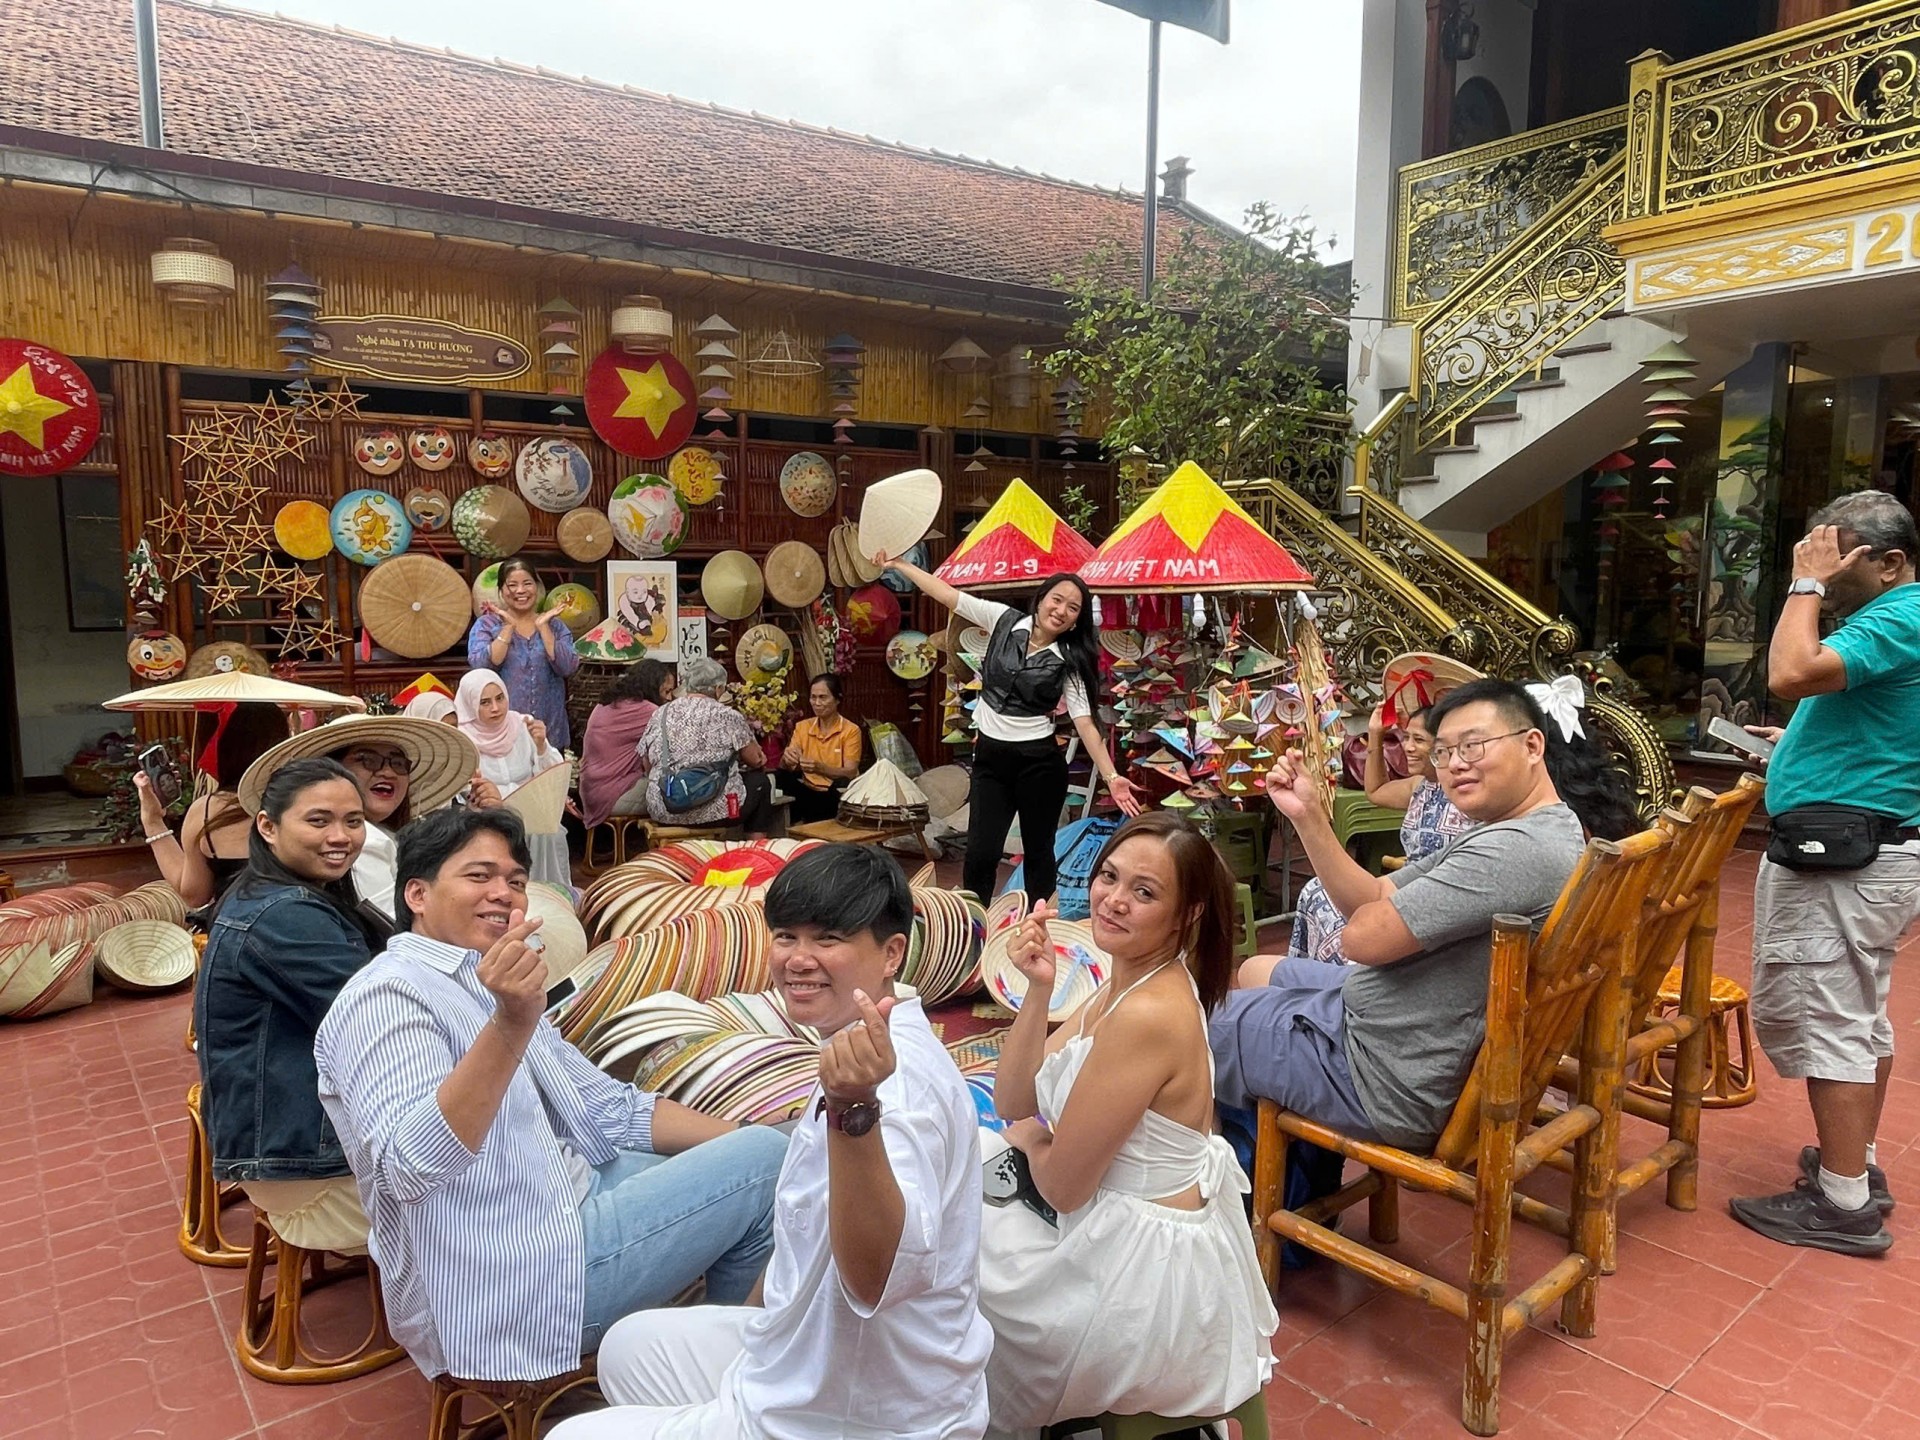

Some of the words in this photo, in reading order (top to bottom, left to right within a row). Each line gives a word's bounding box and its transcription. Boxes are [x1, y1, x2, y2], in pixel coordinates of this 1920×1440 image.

[1864, 211, 1920, 267] 2
[356, 334, 379, 347] Nghệ
[402, 339, 416, 350] TẠ
[416, 340, 437, 351] THU
[439, 342, 473, 354] HƯƠNG
[62, 425, 87, 452] NAM
[946, 562, 987, 579] NAM
[1112, 556, 1158, 582] VIỆT
[1163, 558, 1220, 578] NAM
